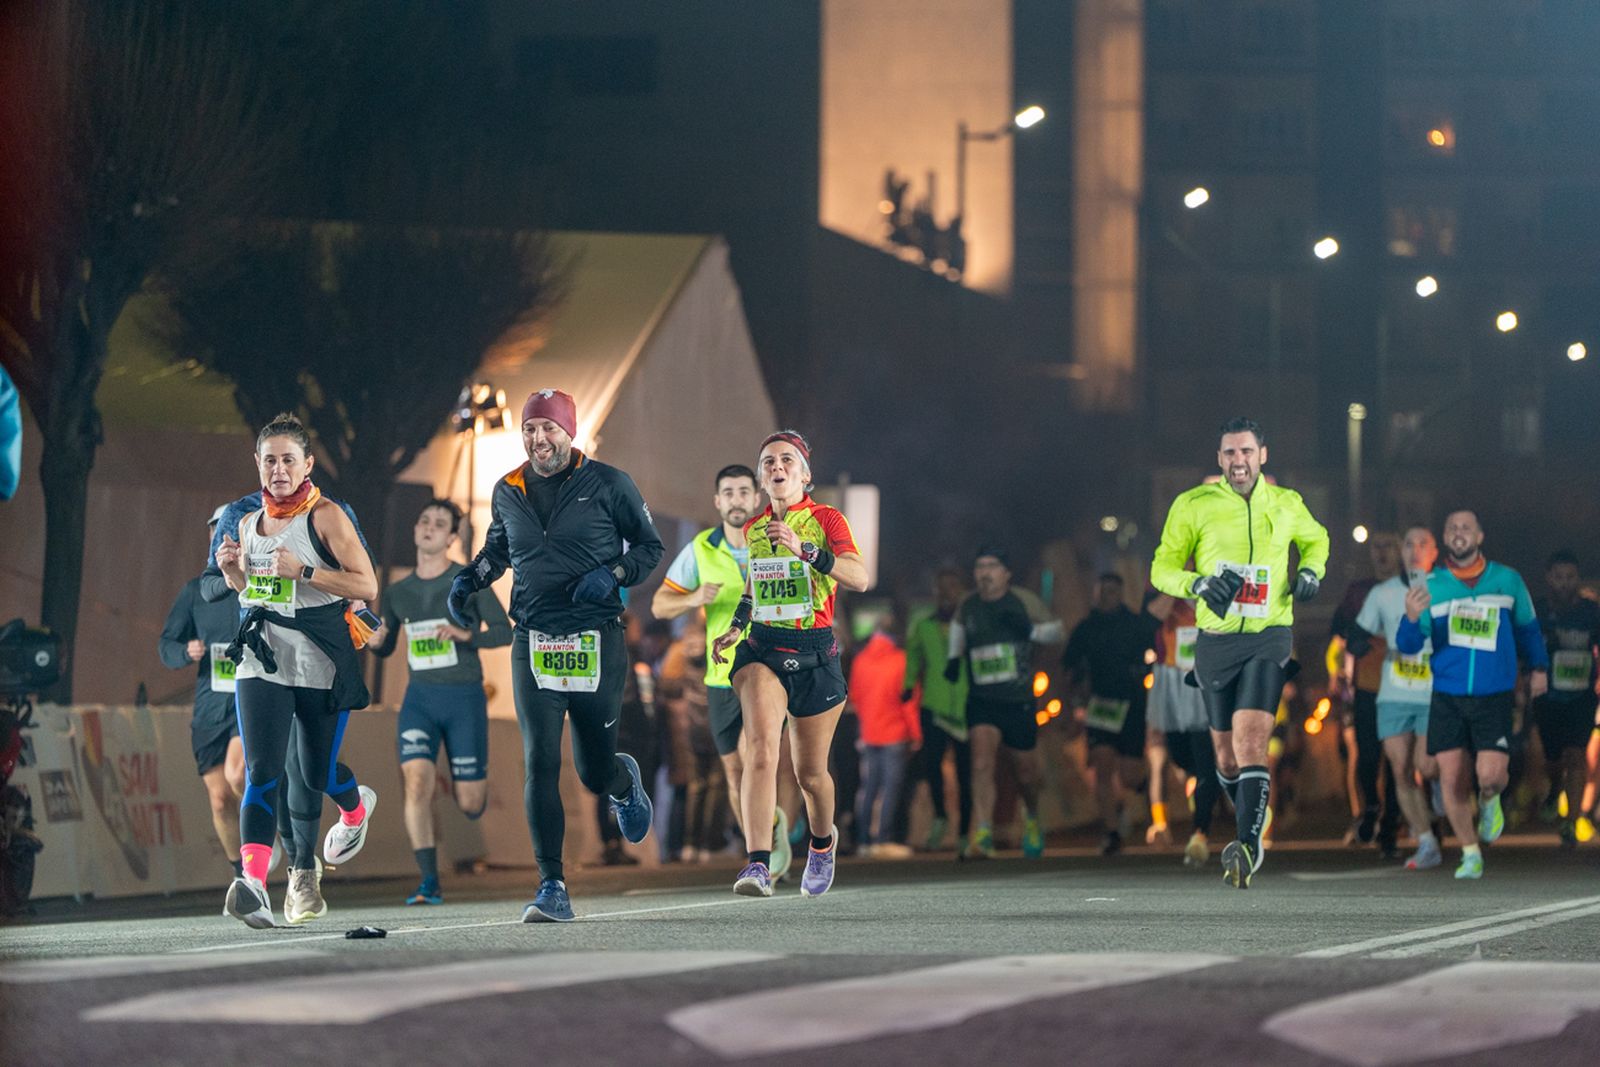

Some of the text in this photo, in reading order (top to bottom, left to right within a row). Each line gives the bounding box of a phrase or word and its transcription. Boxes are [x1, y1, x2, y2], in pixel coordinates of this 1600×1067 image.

[759, 579, 797, 600] 2145
[543, 651, 589, 671] 8369
[1250, 779, 1270, 836] Kalenji
